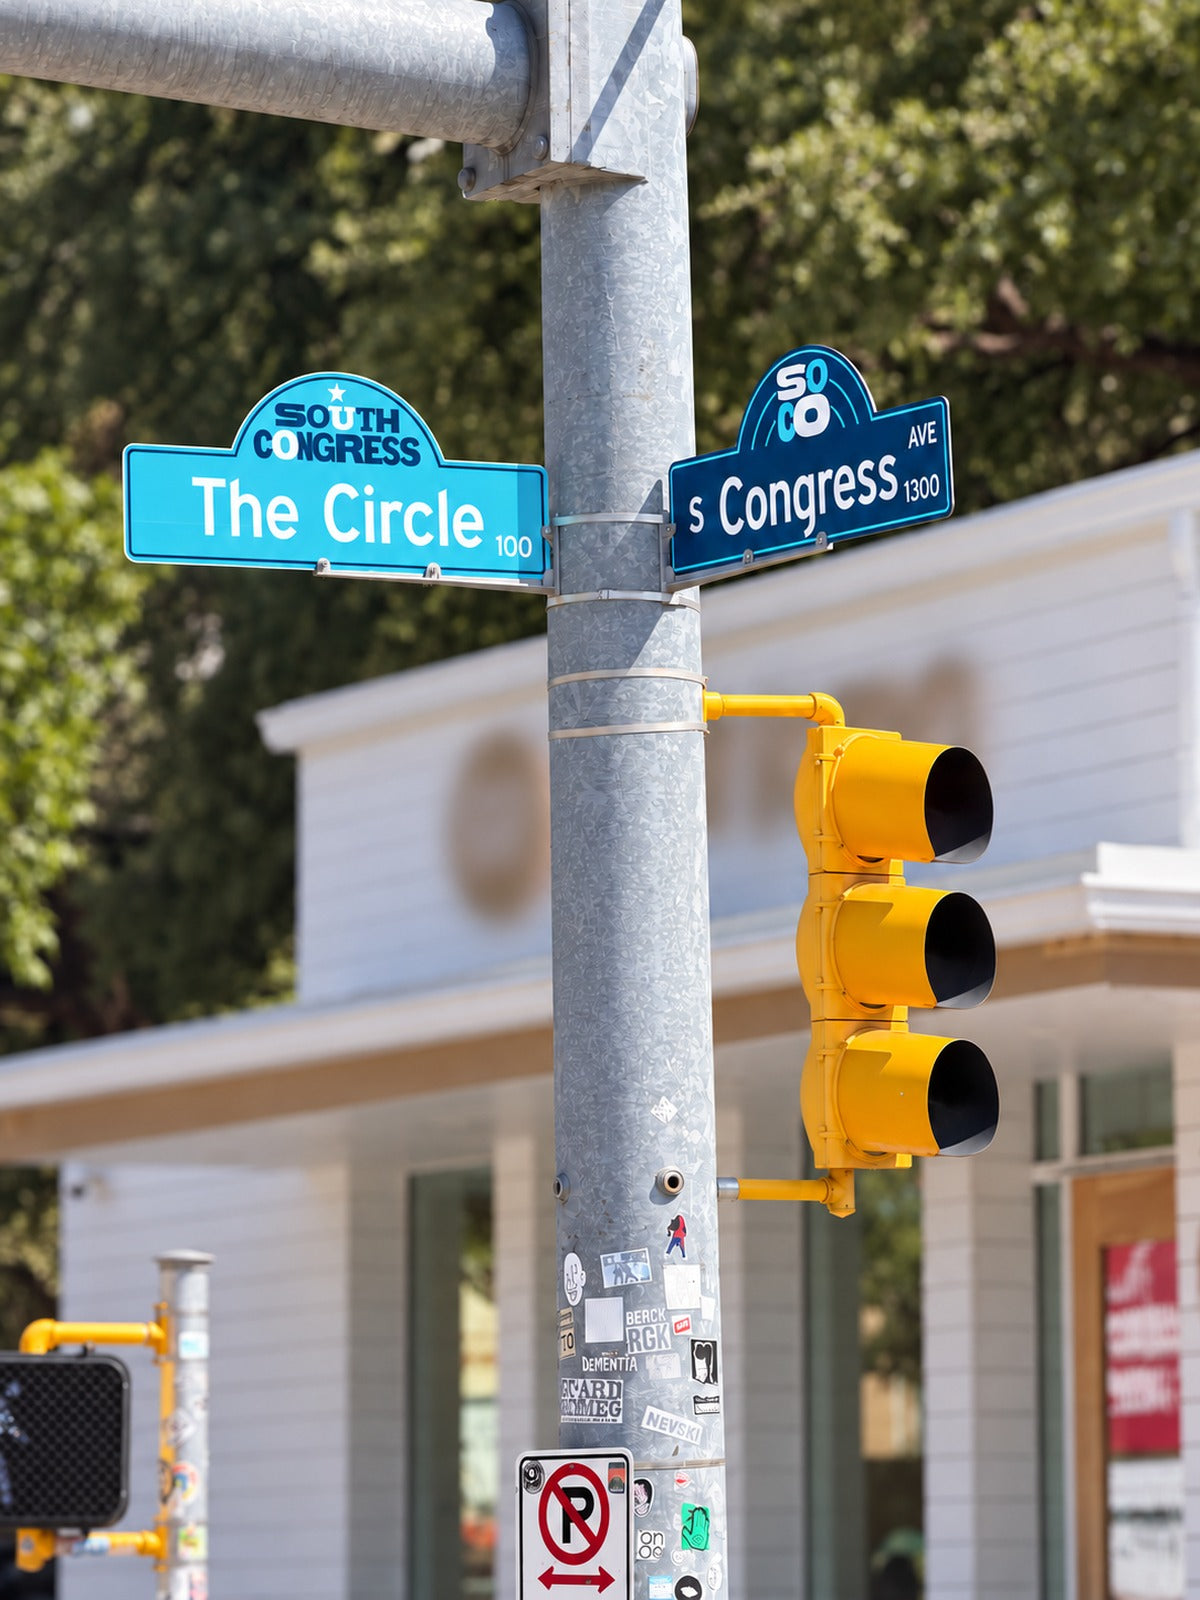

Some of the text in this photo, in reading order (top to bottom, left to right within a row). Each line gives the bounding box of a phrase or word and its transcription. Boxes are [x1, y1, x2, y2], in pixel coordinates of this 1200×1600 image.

[275, 403, 400, 434] SOUTH
[253, 429, 421, 467] CONGRESS
[908, 420, 938, 449] AVE
[719, 454, 899, 538] Congress
[903, 473, 940, 503] 1300
[191, 476, 532, 558] The Circle 100
[626, 1307, 666, 1326] BERCK
[627, 1323, 671, 1353] RGK
[645, 1410, 701, 1442] NEVSKI
